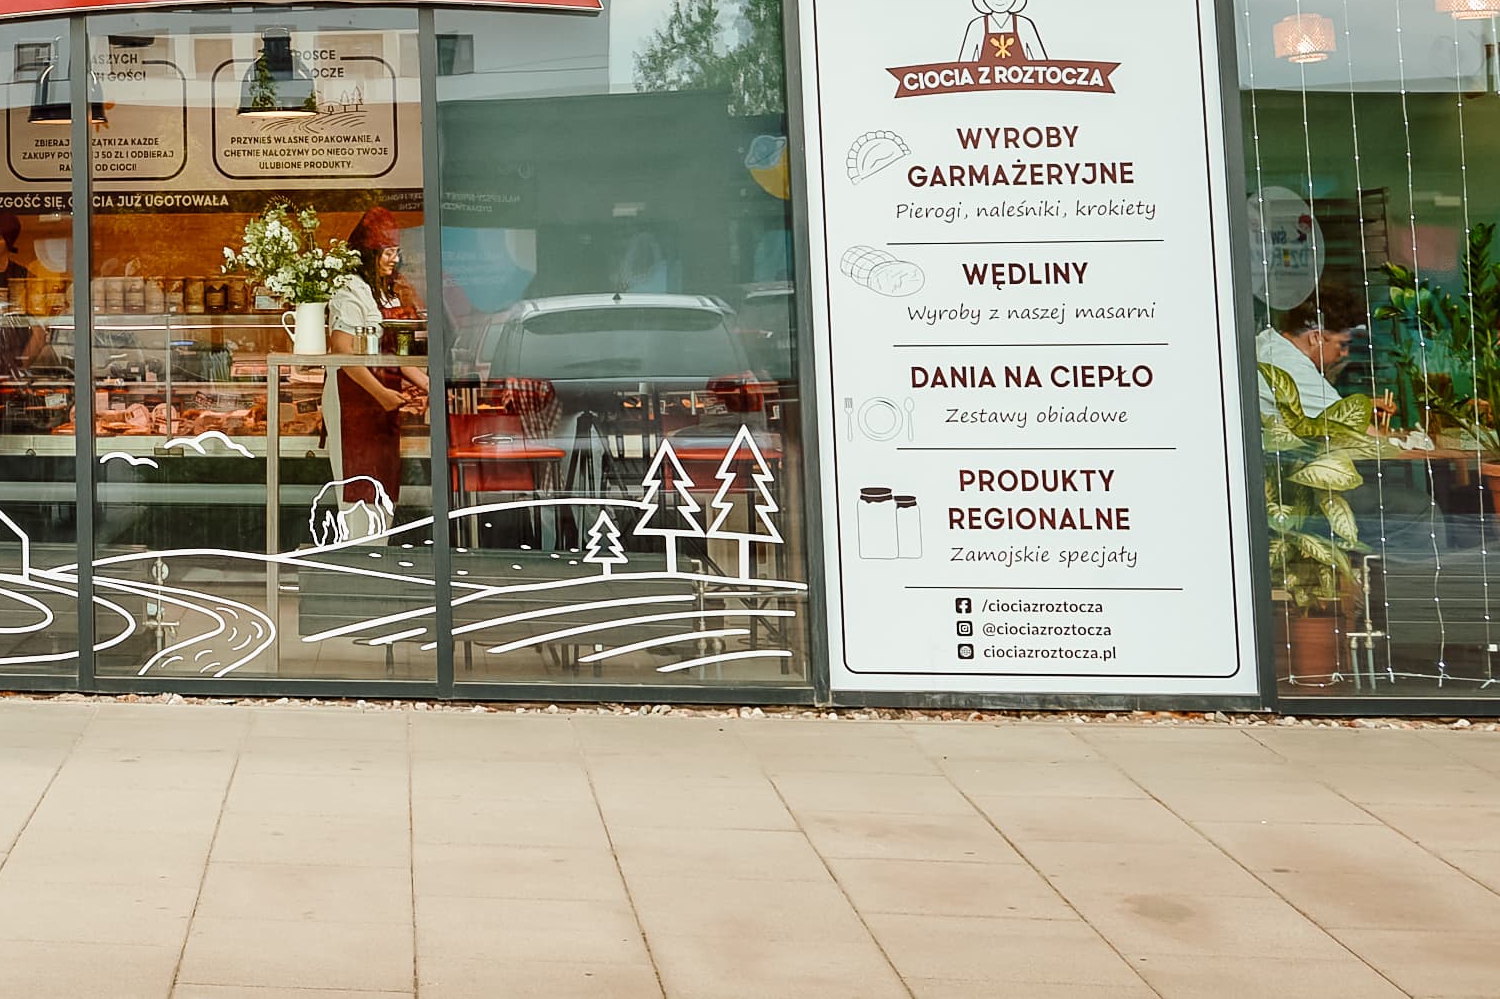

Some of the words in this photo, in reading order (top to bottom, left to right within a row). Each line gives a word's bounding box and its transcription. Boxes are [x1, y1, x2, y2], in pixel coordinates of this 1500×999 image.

[91, 53, 138, 65] ASZYCH
[903, 66, 974, 91] CIOCIA
[978, 66, 992, 85] Z
[995, 65, 1105, 88] ROZTOCZA
[34, 139, 70, 147] ZBIERAJ
[92, 138, 116, 148] ZĄTKI
[117, 138, 129, 146] ZA
[273, 136, 309, 144] WŁASNE
[957, 126, 1080, 150] WYROBY
[22, 151, 55, 160] ZAKUPY
[101, 151, 112, 159] 50
[130, 150, 174, 158] ODBIERAJ
[311, 148, 325, 156] DO
[326, 147, 355, 156] NIEGO
[357, 147, 389, 156] TWOJE
[95, 163, 109, 172] OD
[259, 161, 301, 170] ULUBIONE
[908, 159, 1135, 188] GARMAŻERYJNE
[44, 196, 66, 210] SIĘ,
[117, 193, 142, 208] JUŻ
[144, 194, 229, 207] UGOTOWAŁA
[896, 203, 969, 224] Pierogi,
[976, 200, 1068, 220] naleśniki,
[1075, 200, 1156, 221] krokiety
[962, 262, 1089, 290] WĘDLINY
[908, 304, 981, 326] Wyroby
[989, 308, 1000, 320] z
[1008, 303, 1066, 324] naszej
[1075, 302, 1156, 320] masarni
[911, 366, 997, 389] DANIA
[1004, 366, 1042, 388] NA
[1050, 364, 1154, 388] CIEPŁO
[945, 407, 1028, 428] Zestawy
[1036, 407, 1129, 424] obiadowe
[959, 469, 1115, 492] PRODUKTY
[948, 507, 1131, 530] REGIONALNE
[950, 545, 1051, 568] Zamojskie
[1058, 546, 1139, 568] specjały
[982, 598, 1103, 615] /ciociazroztocza
[982, 621, 1112, 637] @ciociazroztocza
[983, 644, 1117, 662] ciociazroztocza.pl
